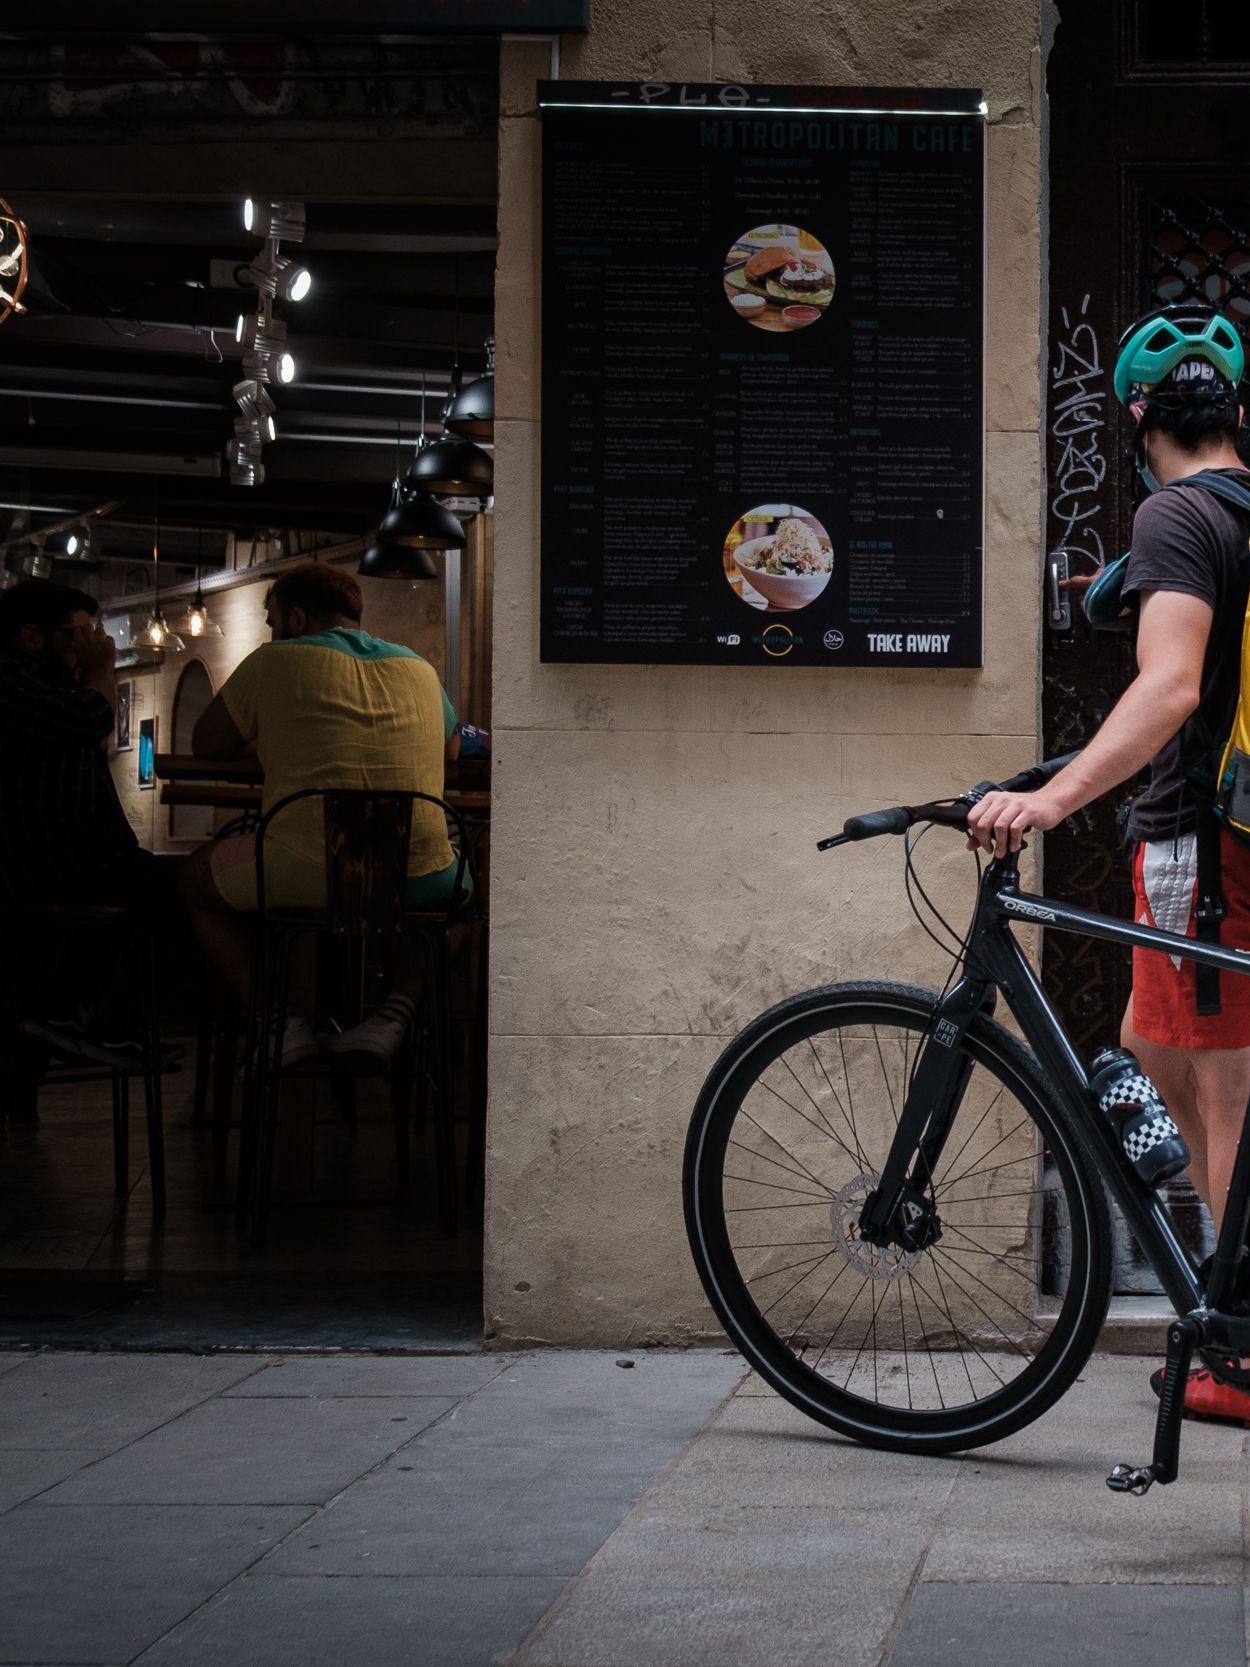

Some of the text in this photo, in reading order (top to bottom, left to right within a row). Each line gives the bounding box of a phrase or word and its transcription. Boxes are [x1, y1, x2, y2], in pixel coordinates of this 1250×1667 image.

[912, 125, 973, 153] CAFE
[867, 633, 951, 653] TAKE AWAY
[1004, 900, 1056, 922] ORBEA
